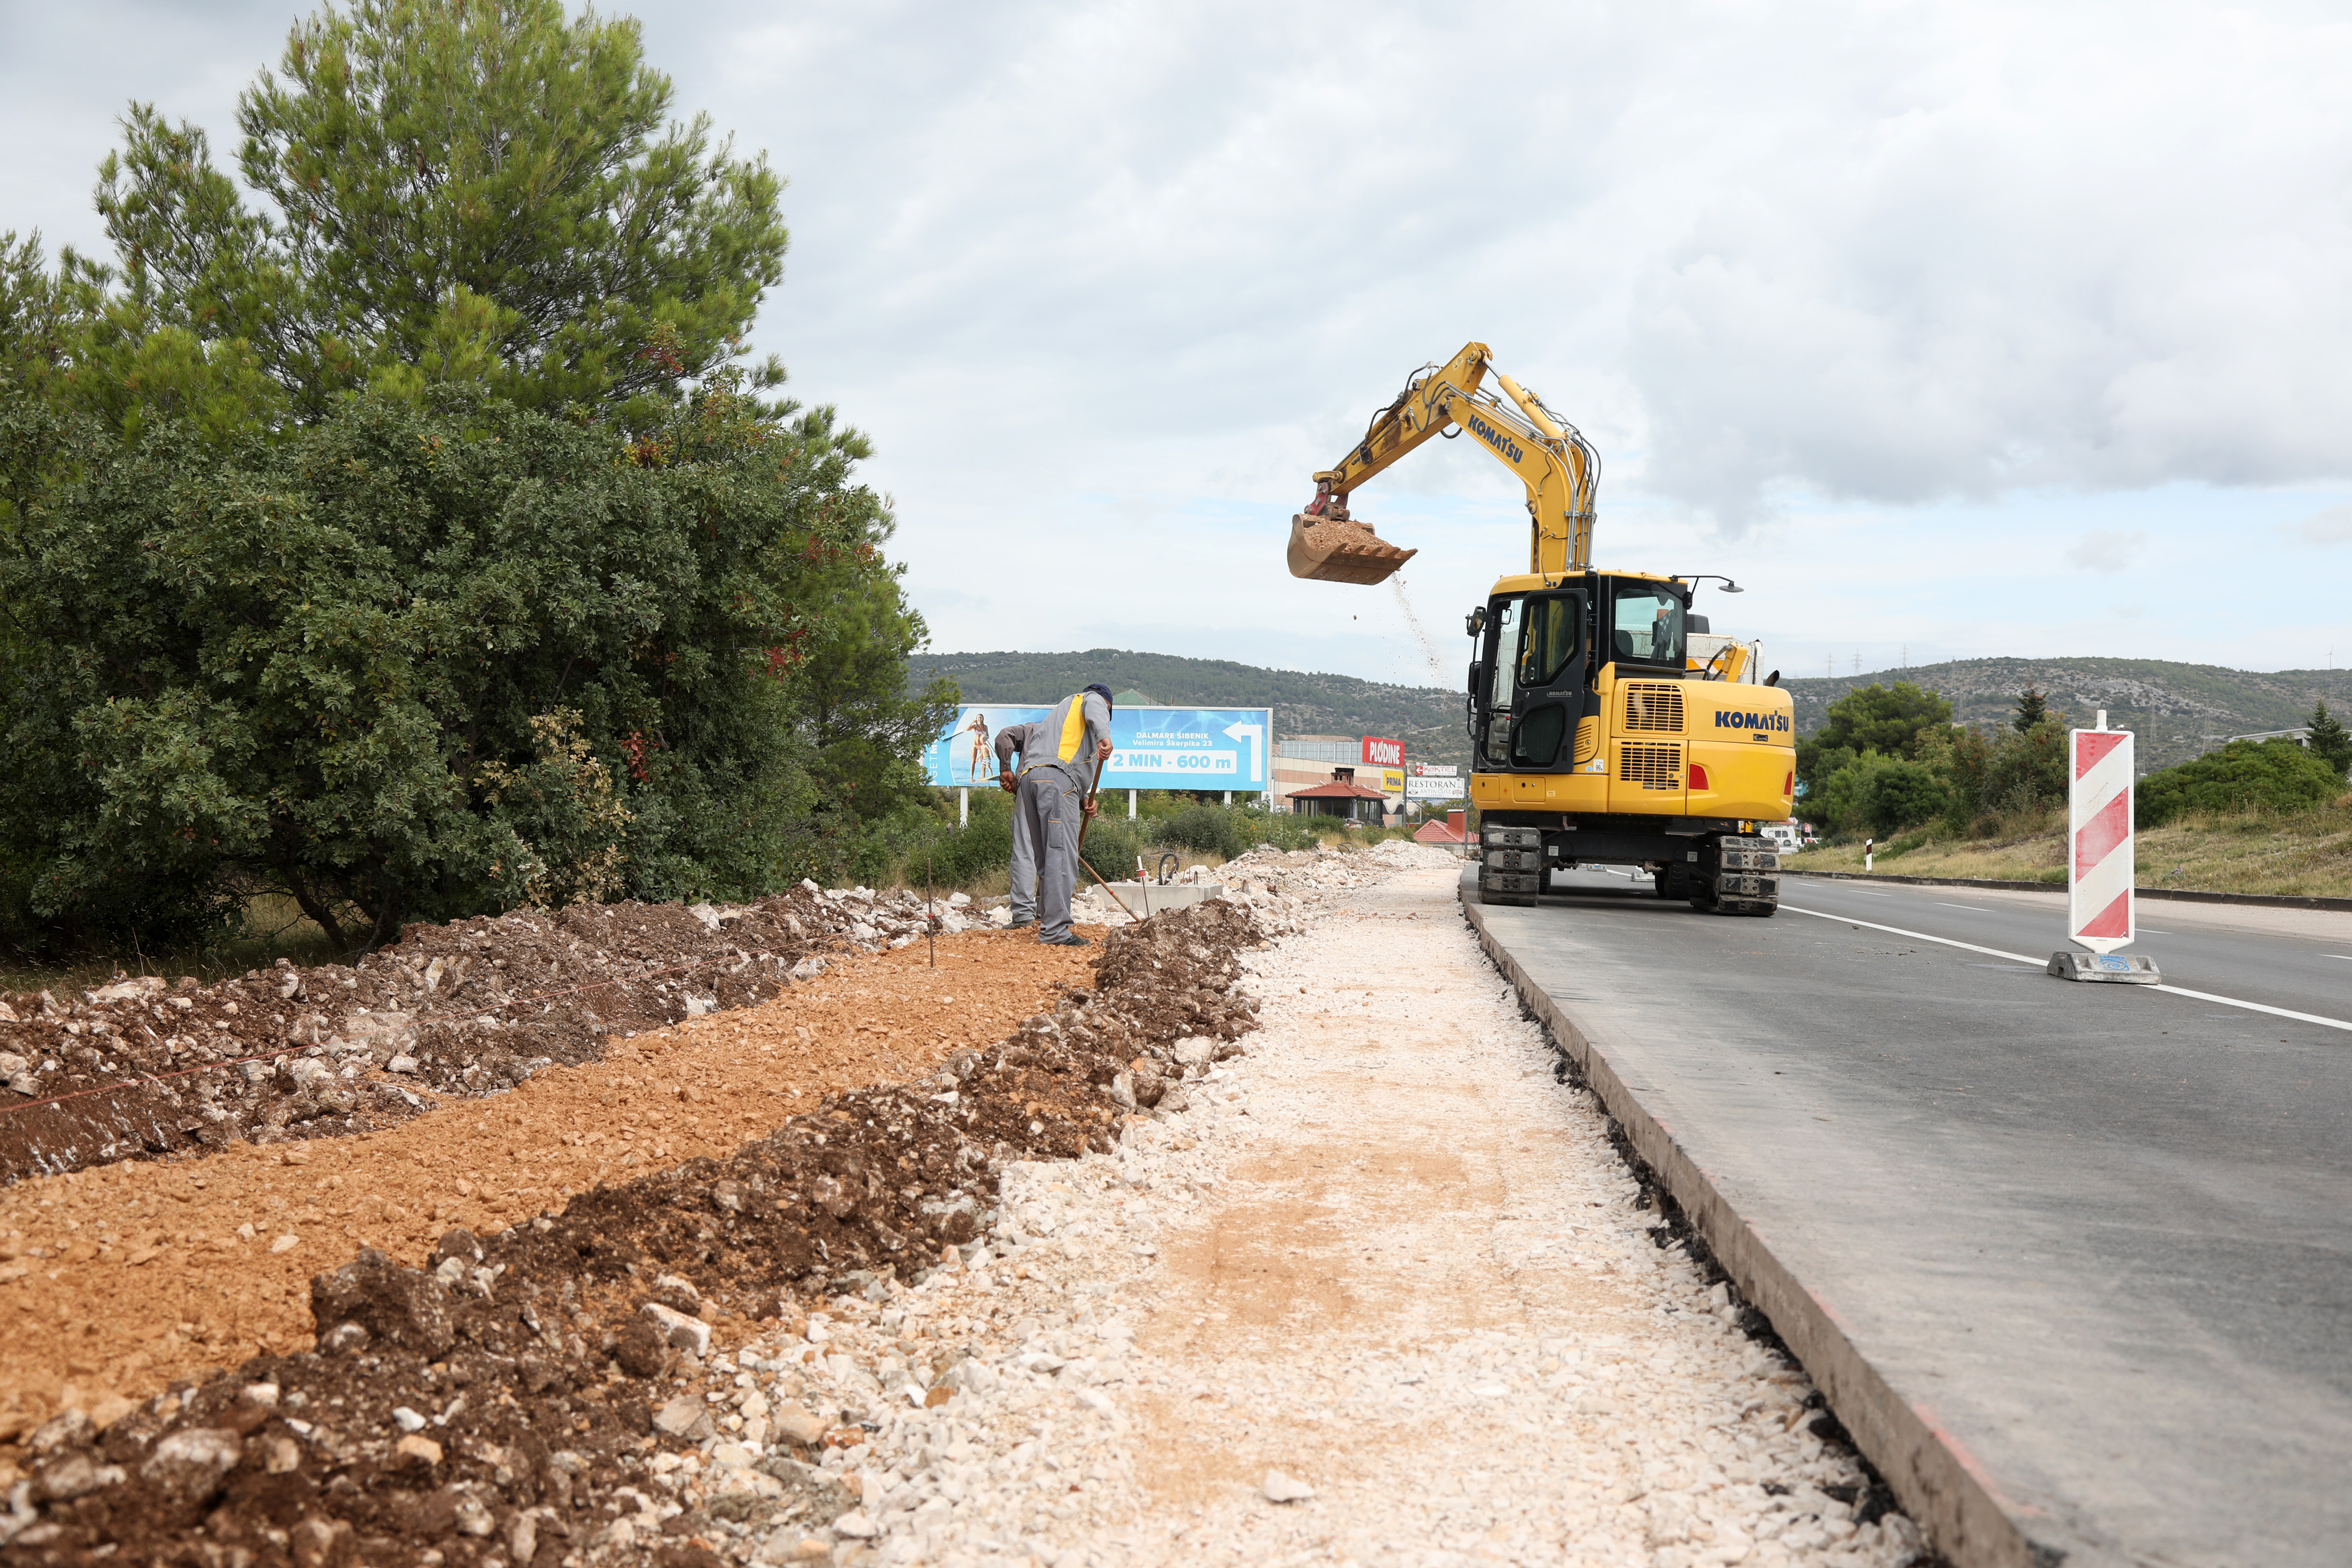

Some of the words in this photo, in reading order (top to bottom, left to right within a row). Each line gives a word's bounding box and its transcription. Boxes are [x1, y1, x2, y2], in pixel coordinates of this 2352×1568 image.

[1468, 413, 1524, 463] KOMATSU
[1715, 710, 1789, 732] KOMATSU
[1177, 731, 1209, 739] ŠIBENIK
[1166, 738, 1200, 747] Škorpika
[1369, 741, 1401, 765] PLODINE
[1113, 754, 1124, 767] 2
[1128, 754, 1162, 767] MIN
[1177, 755, 1211, 768] 600
[1215, 758, 1231, 768] m
[1387, 777, 1401, 787] PRIMA
[1408, 780, 1456, 788] RESTORAN
